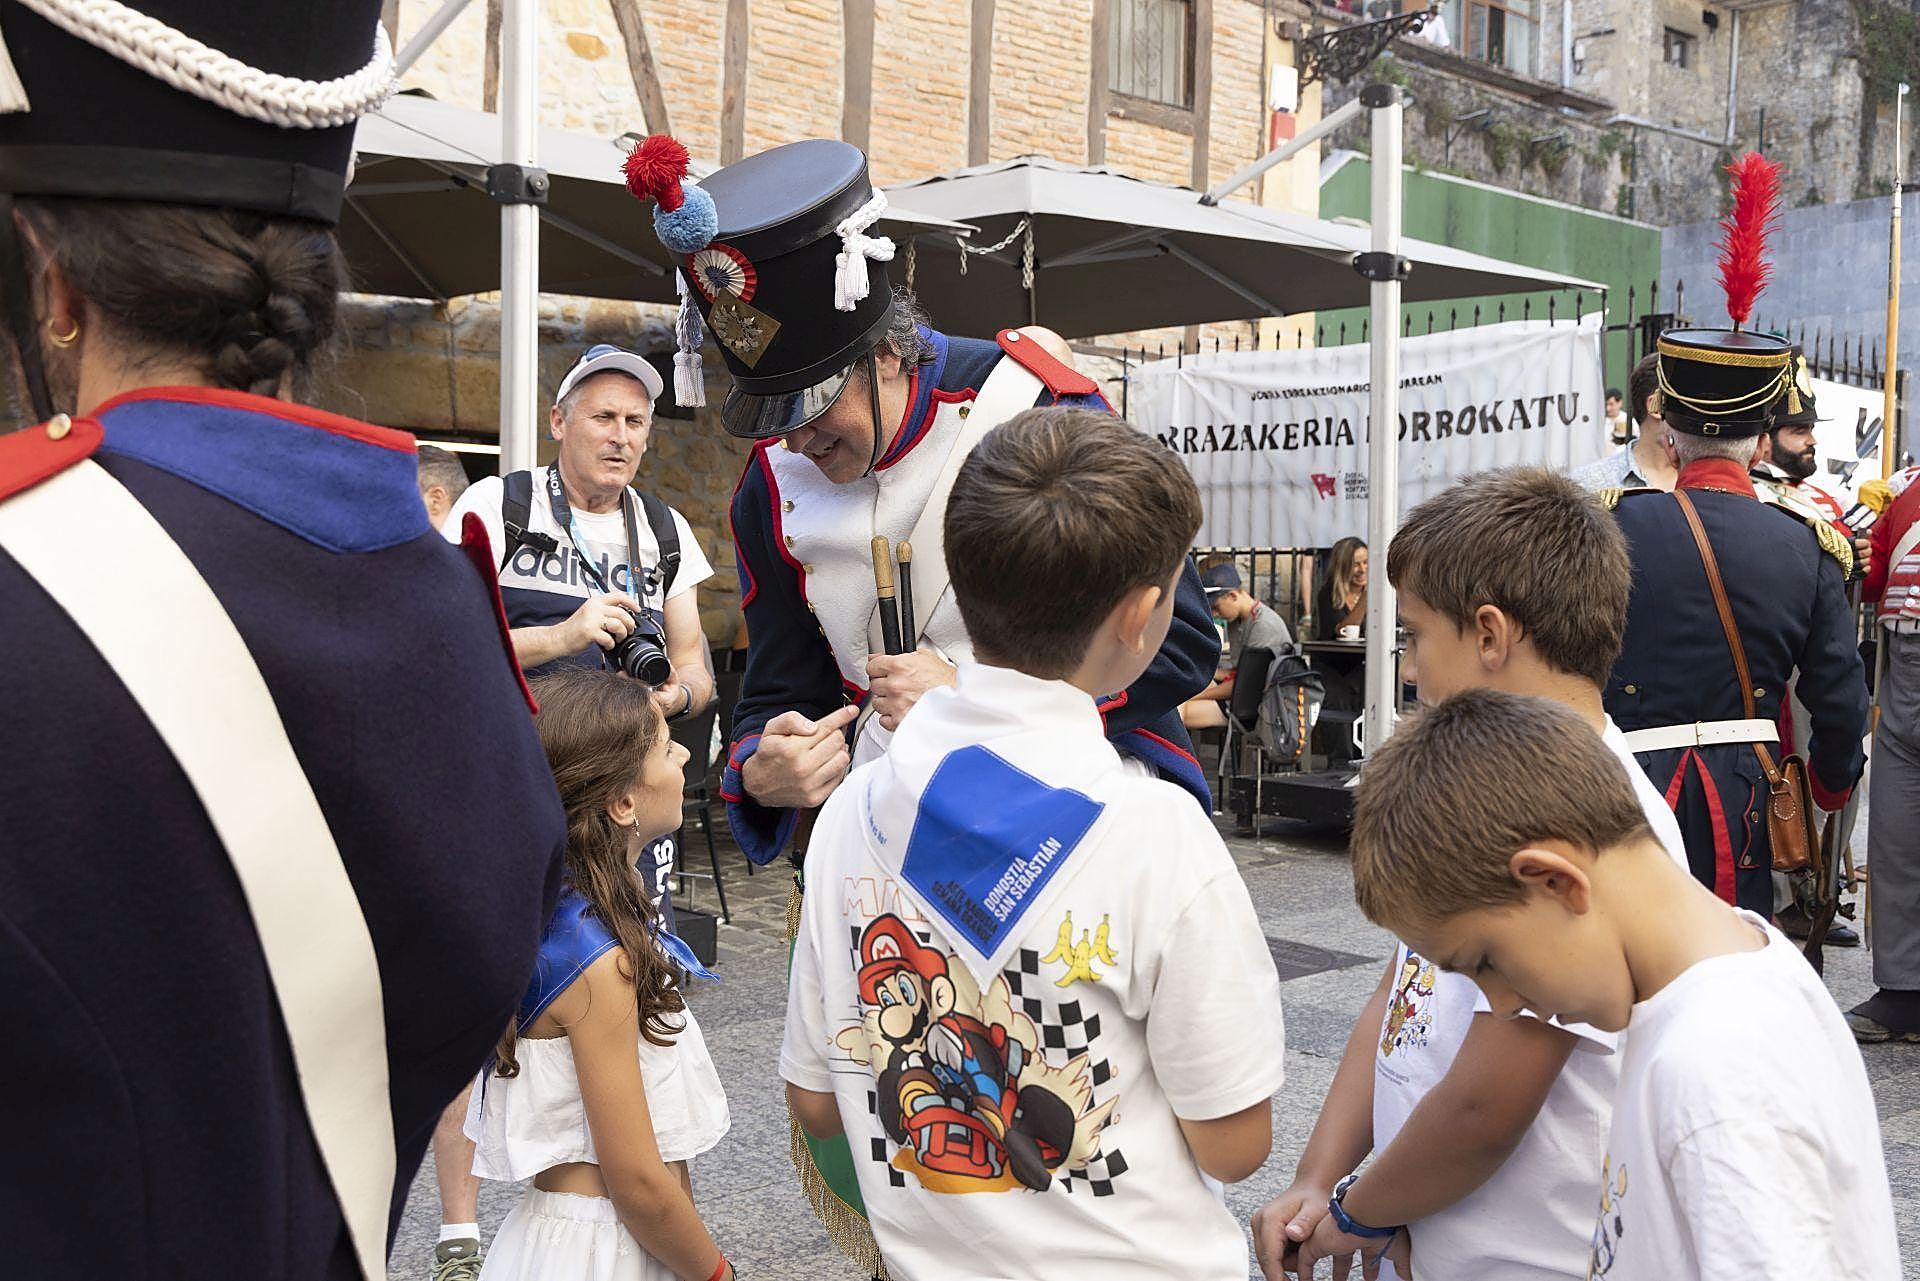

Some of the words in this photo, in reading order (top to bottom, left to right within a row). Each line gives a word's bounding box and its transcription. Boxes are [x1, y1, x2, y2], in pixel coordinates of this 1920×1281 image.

[1399, 374, 1443, 389] URREAN
[1366, 392, 1590, 443] RROKATU.
[983, 856, 1028, 912] DONOSTIA
[994, 895, 1017, 922] SAN
